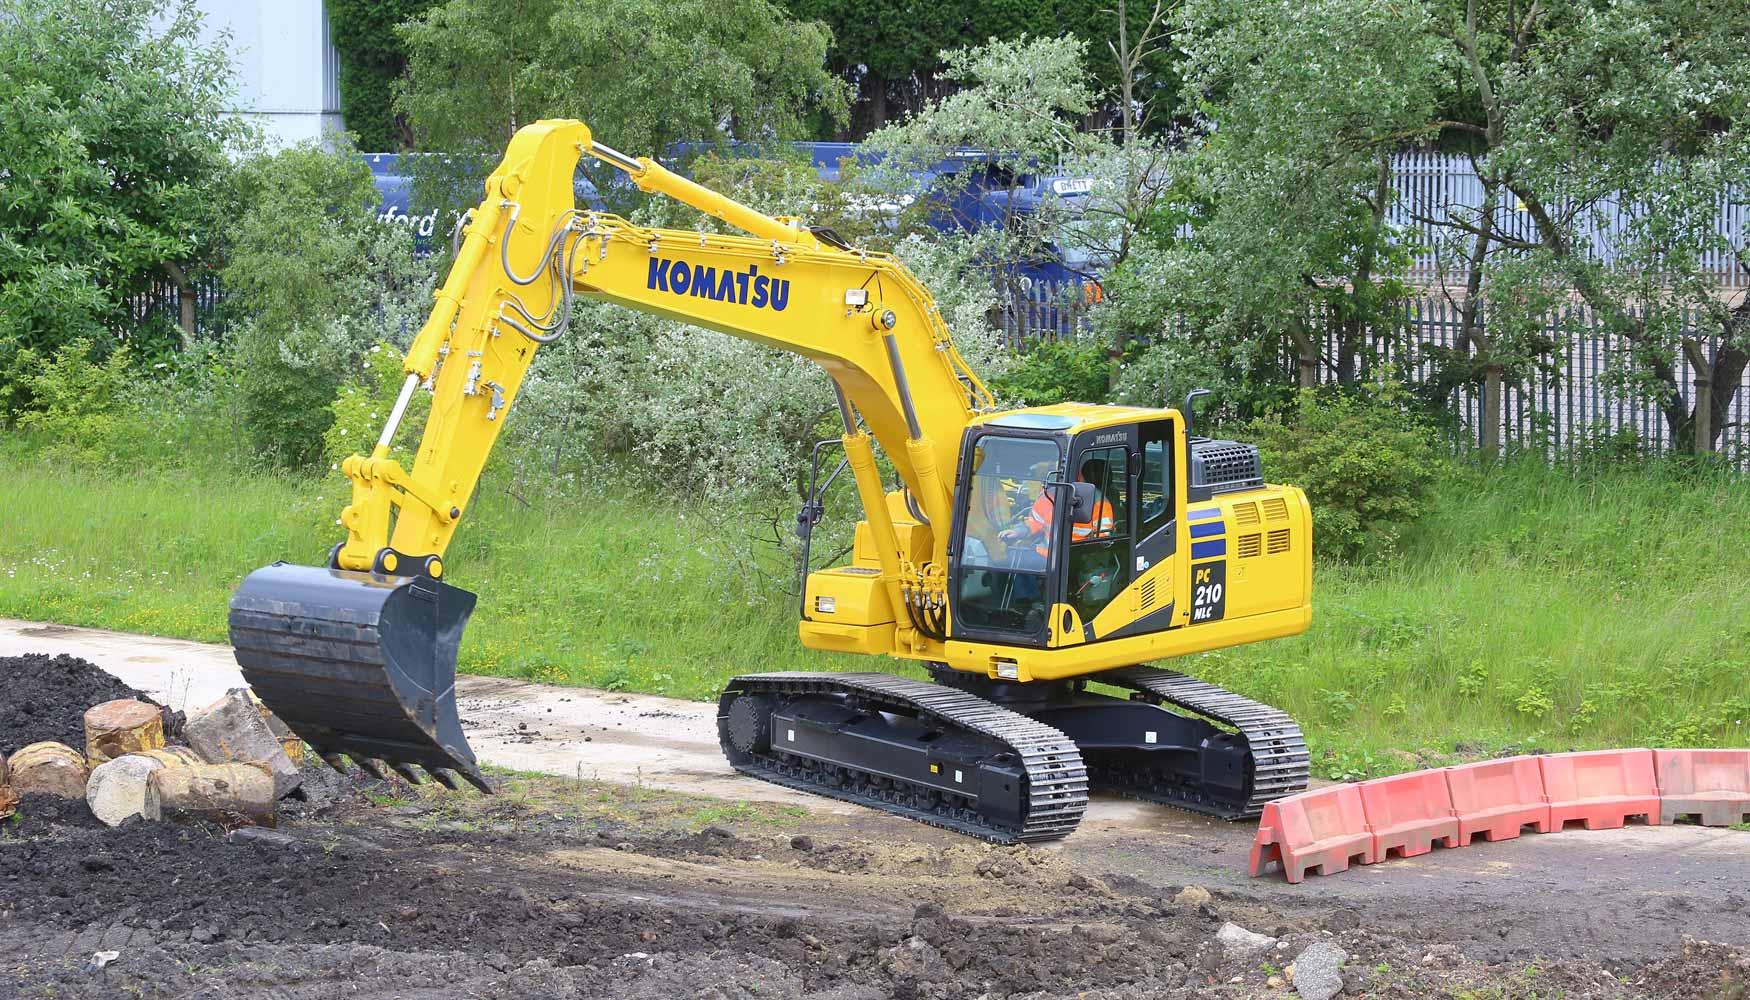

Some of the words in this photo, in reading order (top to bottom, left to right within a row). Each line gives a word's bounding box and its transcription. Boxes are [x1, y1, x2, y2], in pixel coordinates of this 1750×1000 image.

[647, 256, 790, 311] KOMATSU
[1096, 431, 1128, 444] KOMATSU
[1195, 568, 1211, 585] PC
[1194, 583, 1222, 606] 210
[1193, 606, 1213, 620] NLC
